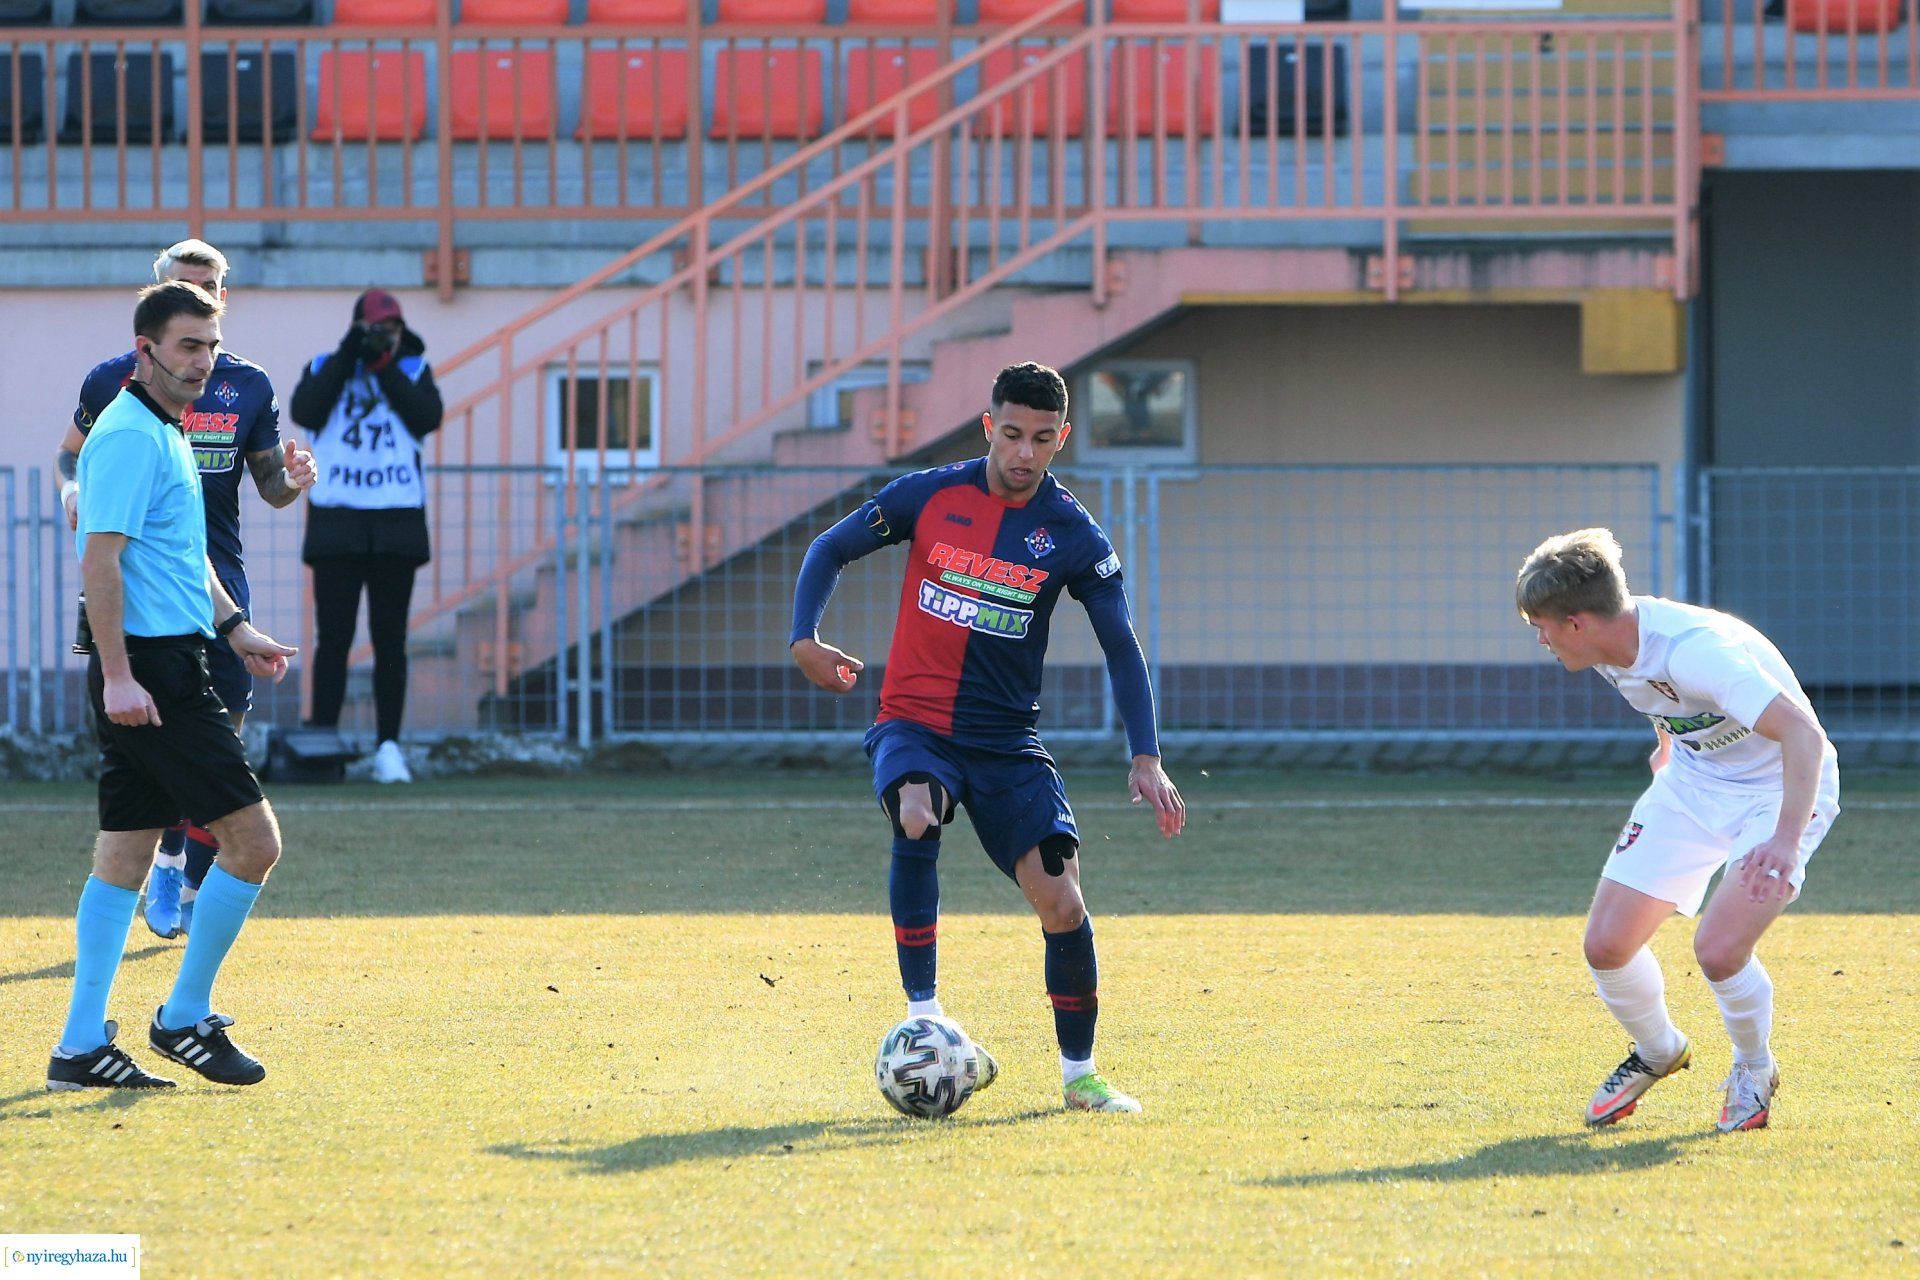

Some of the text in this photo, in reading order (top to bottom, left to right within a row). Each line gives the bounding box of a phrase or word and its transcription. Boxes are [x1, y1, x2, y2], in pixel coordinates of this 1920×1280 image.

[182, 412, 239, 432] VESZ
[943, 573, 1033, 601] ALWAYS ON THE RIGHT WAY
[1057, 811, 1074, 825] JAK
